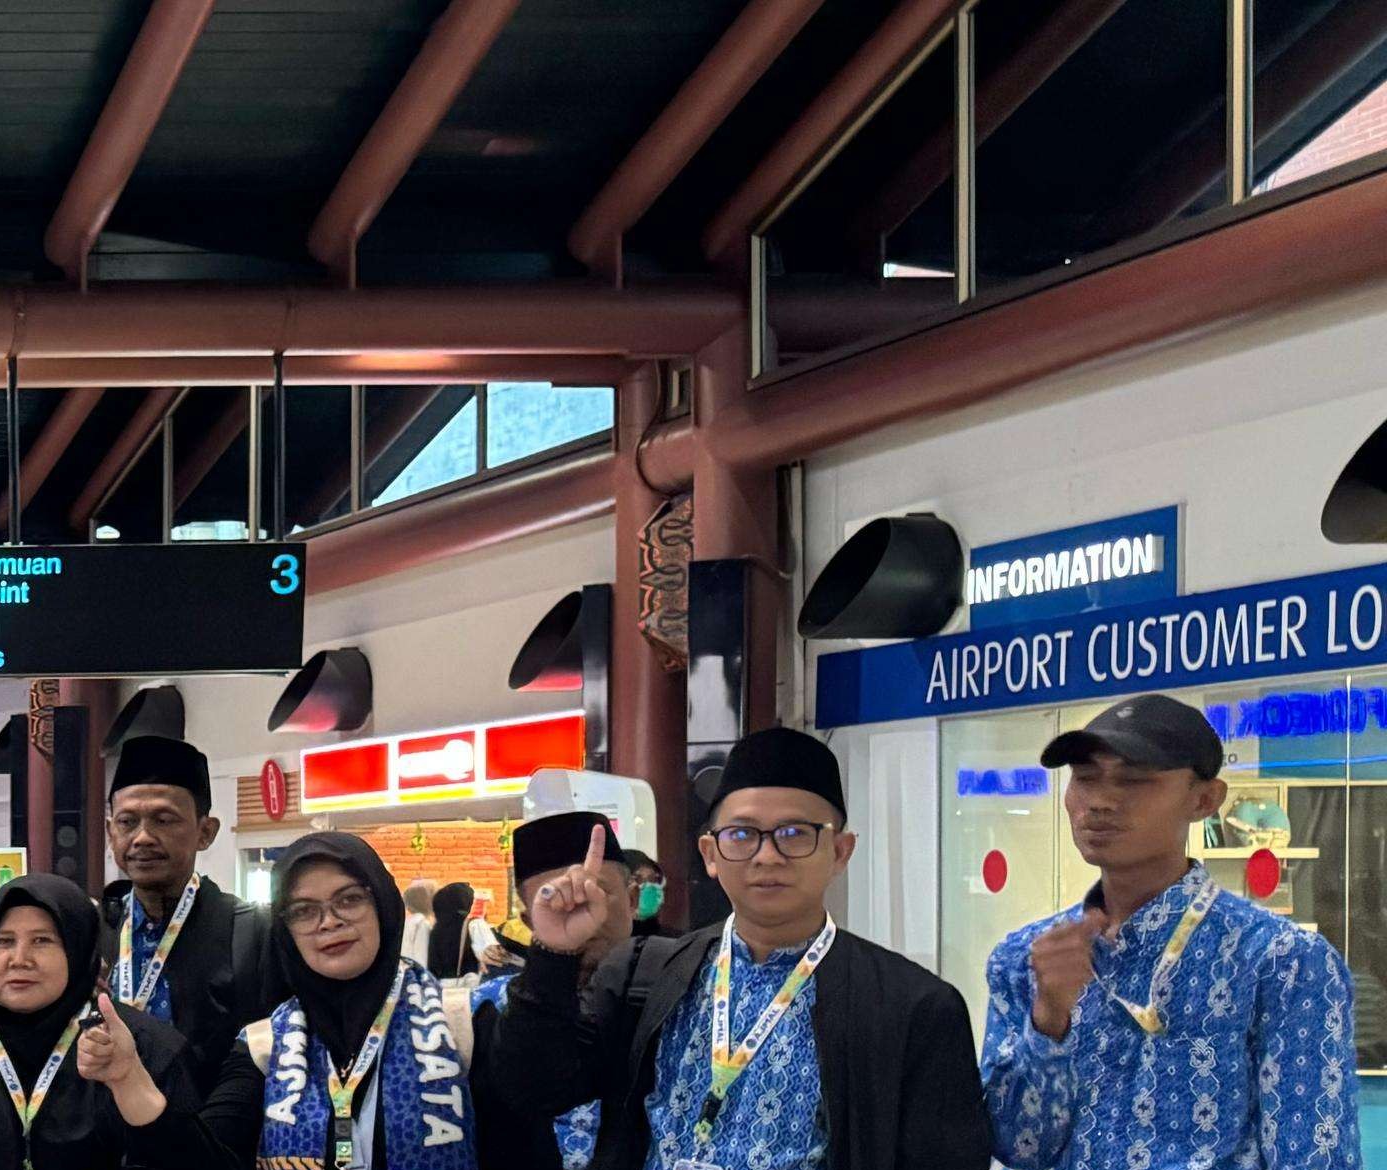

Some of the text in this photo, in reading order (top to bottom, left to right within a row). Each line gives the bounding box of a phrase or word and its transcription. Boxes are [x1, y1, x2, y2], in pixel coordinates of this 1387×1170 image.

[270, 554, 299, 594] 3
[966, 533, 1155, 605] INFORMATION
[926, 630, 1073, 704] AIRPORT
[1087, 596, 1307, 683] CUSTOMER
[755, 1008, 781, 1041] AJMAL
